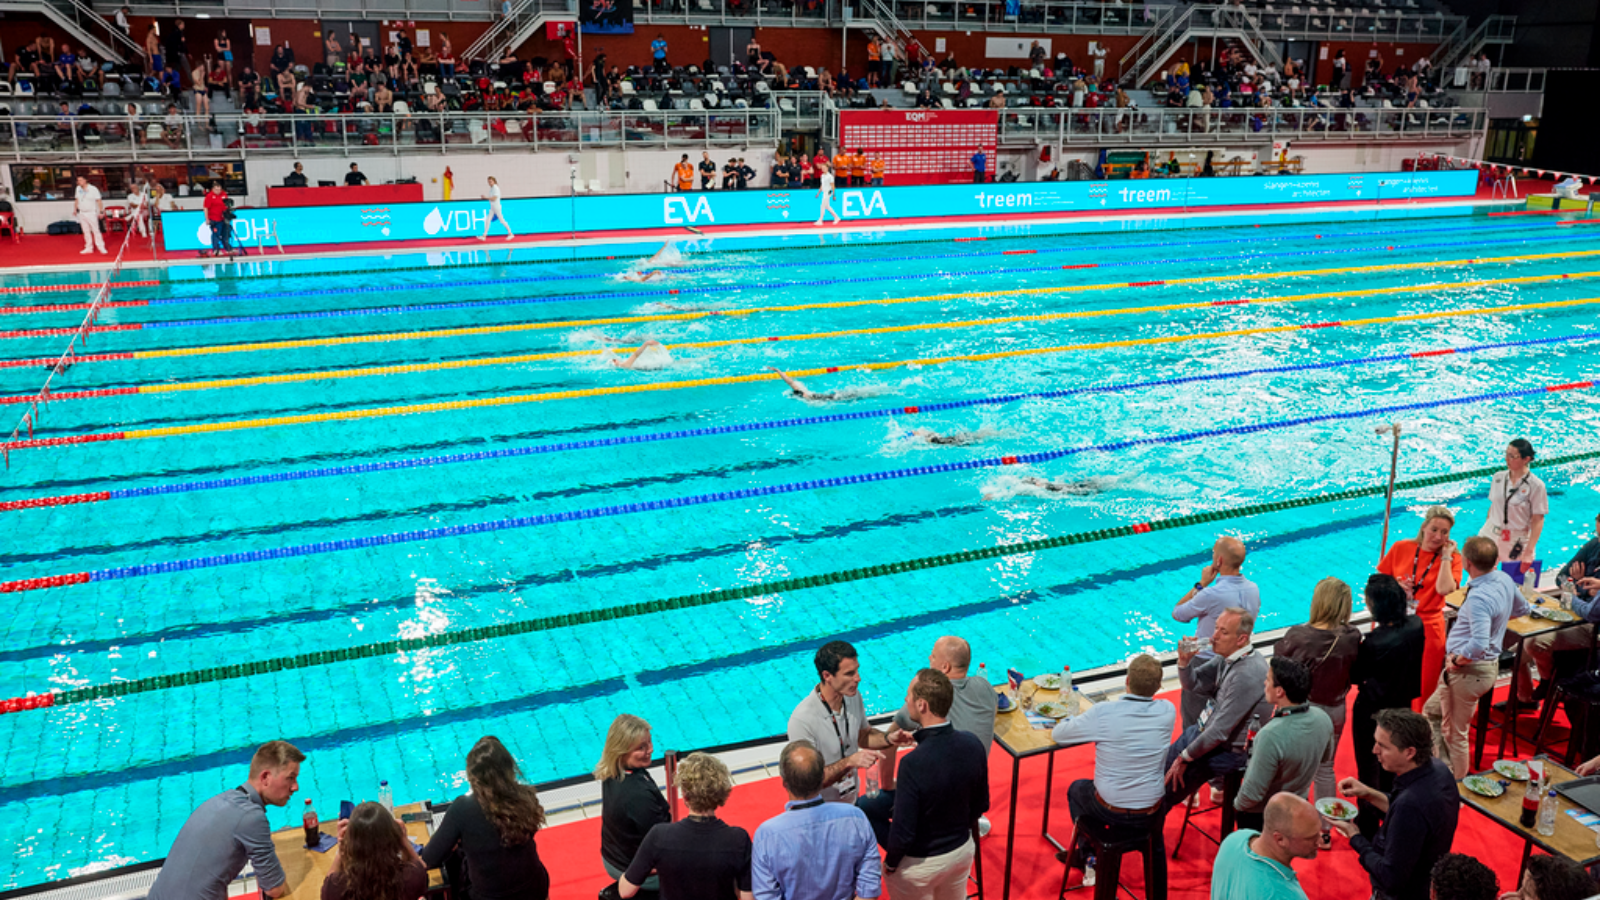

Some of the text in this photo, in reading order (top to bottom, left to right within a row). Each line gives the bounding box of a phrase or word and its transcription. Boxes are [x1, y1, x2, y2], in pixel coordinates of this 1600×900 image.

[842, 190, 888, 217] EVA
[974, 191, 1032, 208] treem
[1118, 187, 1171, 202] treem
[663, 195, 715, 224] EVA
[231, 218, 270, 241] DH
